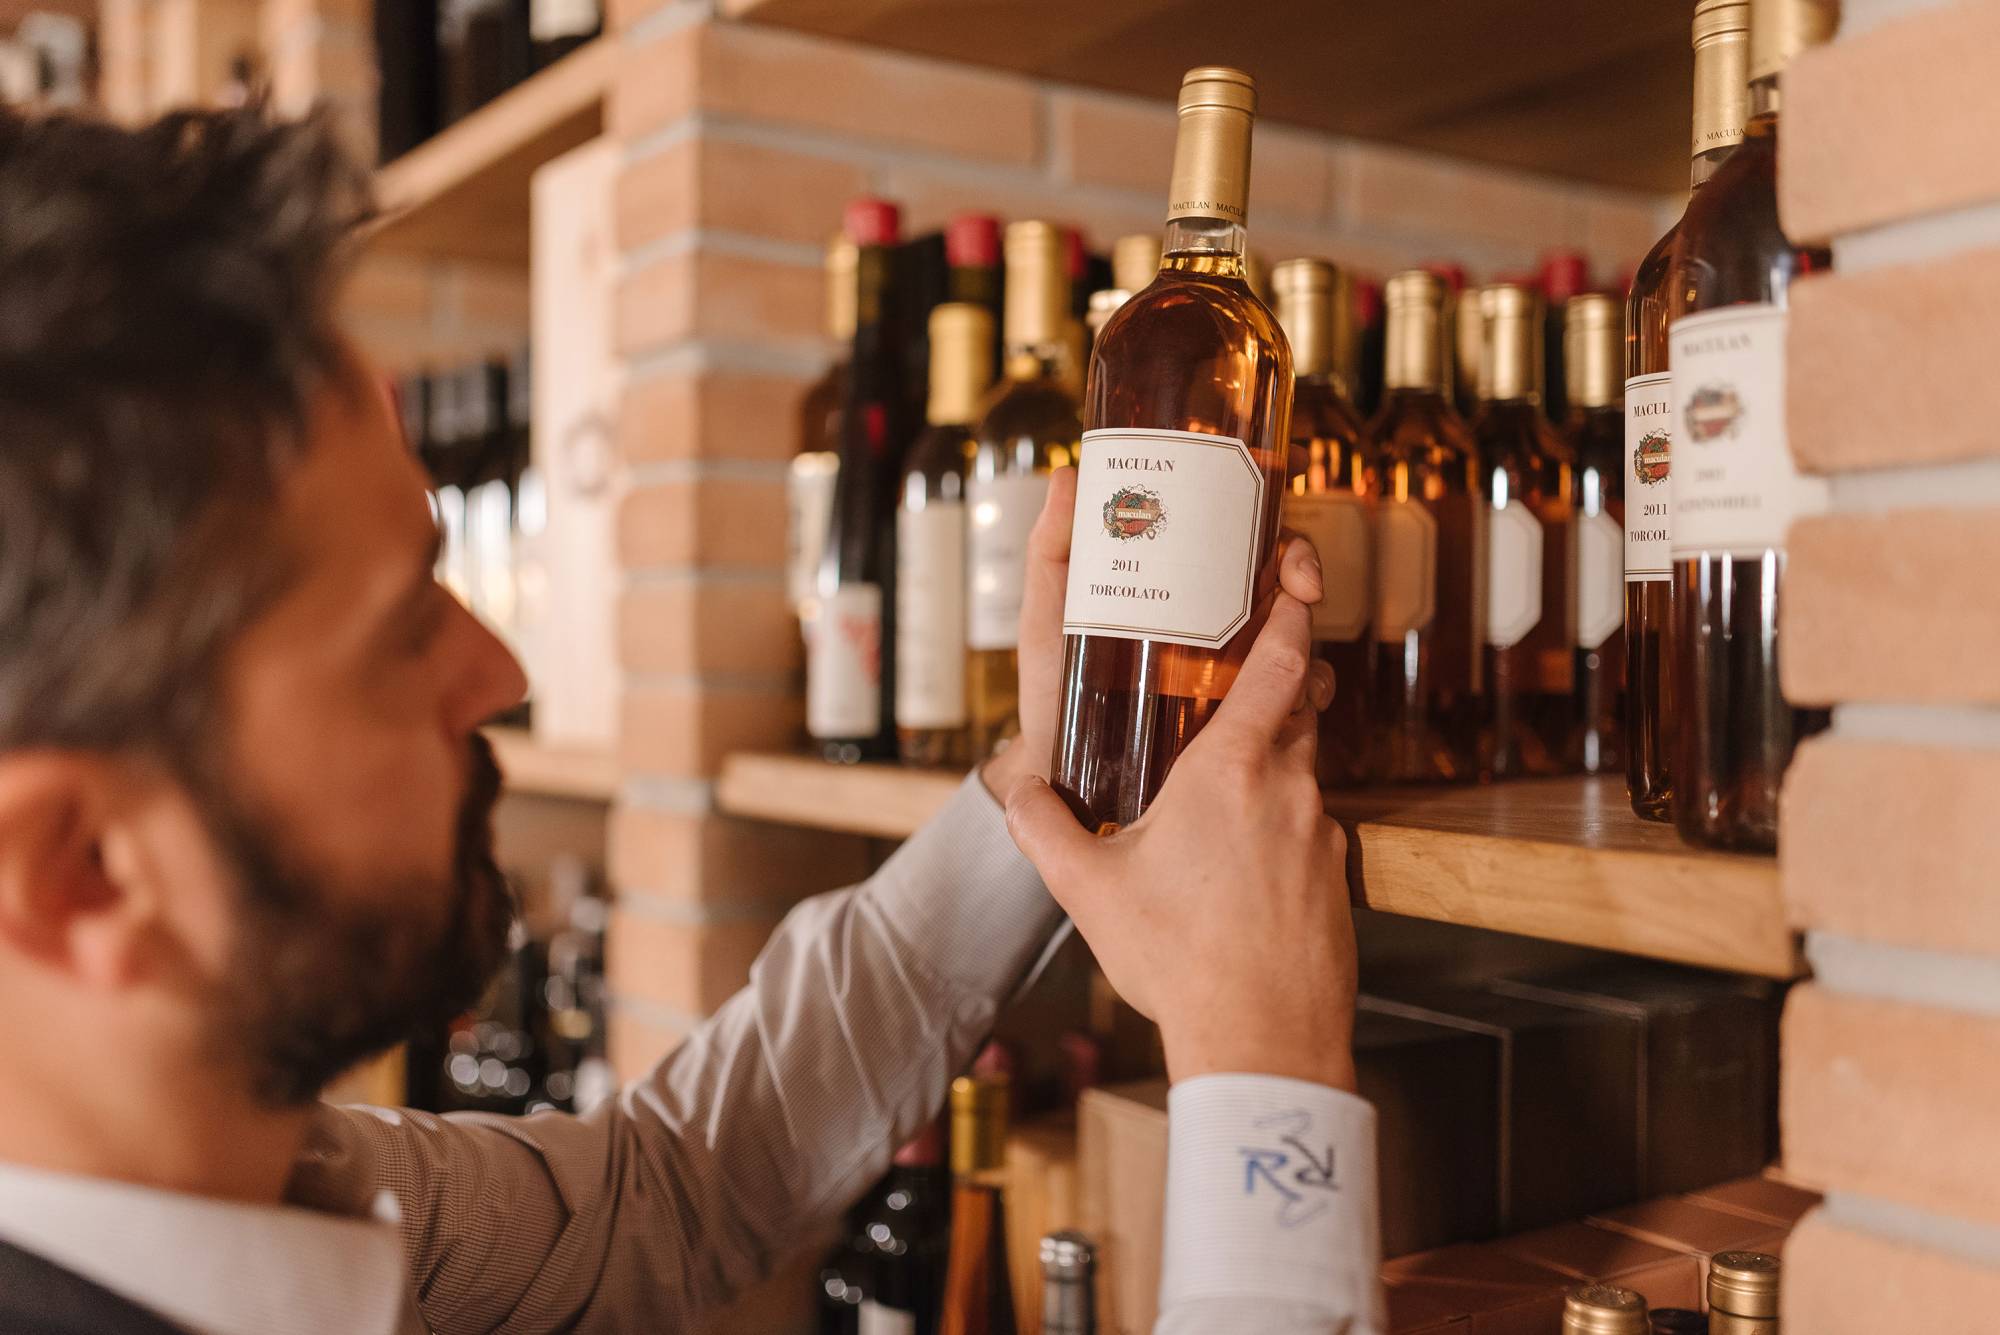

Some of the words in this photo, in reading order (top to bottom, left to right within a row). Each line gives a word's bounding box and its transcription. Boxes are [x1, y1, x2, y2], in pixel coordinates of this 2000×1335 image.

[1173, 201, 1210, 210] MACULAN
[1107, 457, 1175, 472] MACULAN
[1118, 509, 1151, 520] maculan
[1643, 503, 1667, 516] 2011
[1111, 559, 1140, 573] 2011
[1089, 584, 1170, 601] TORCOLATO
